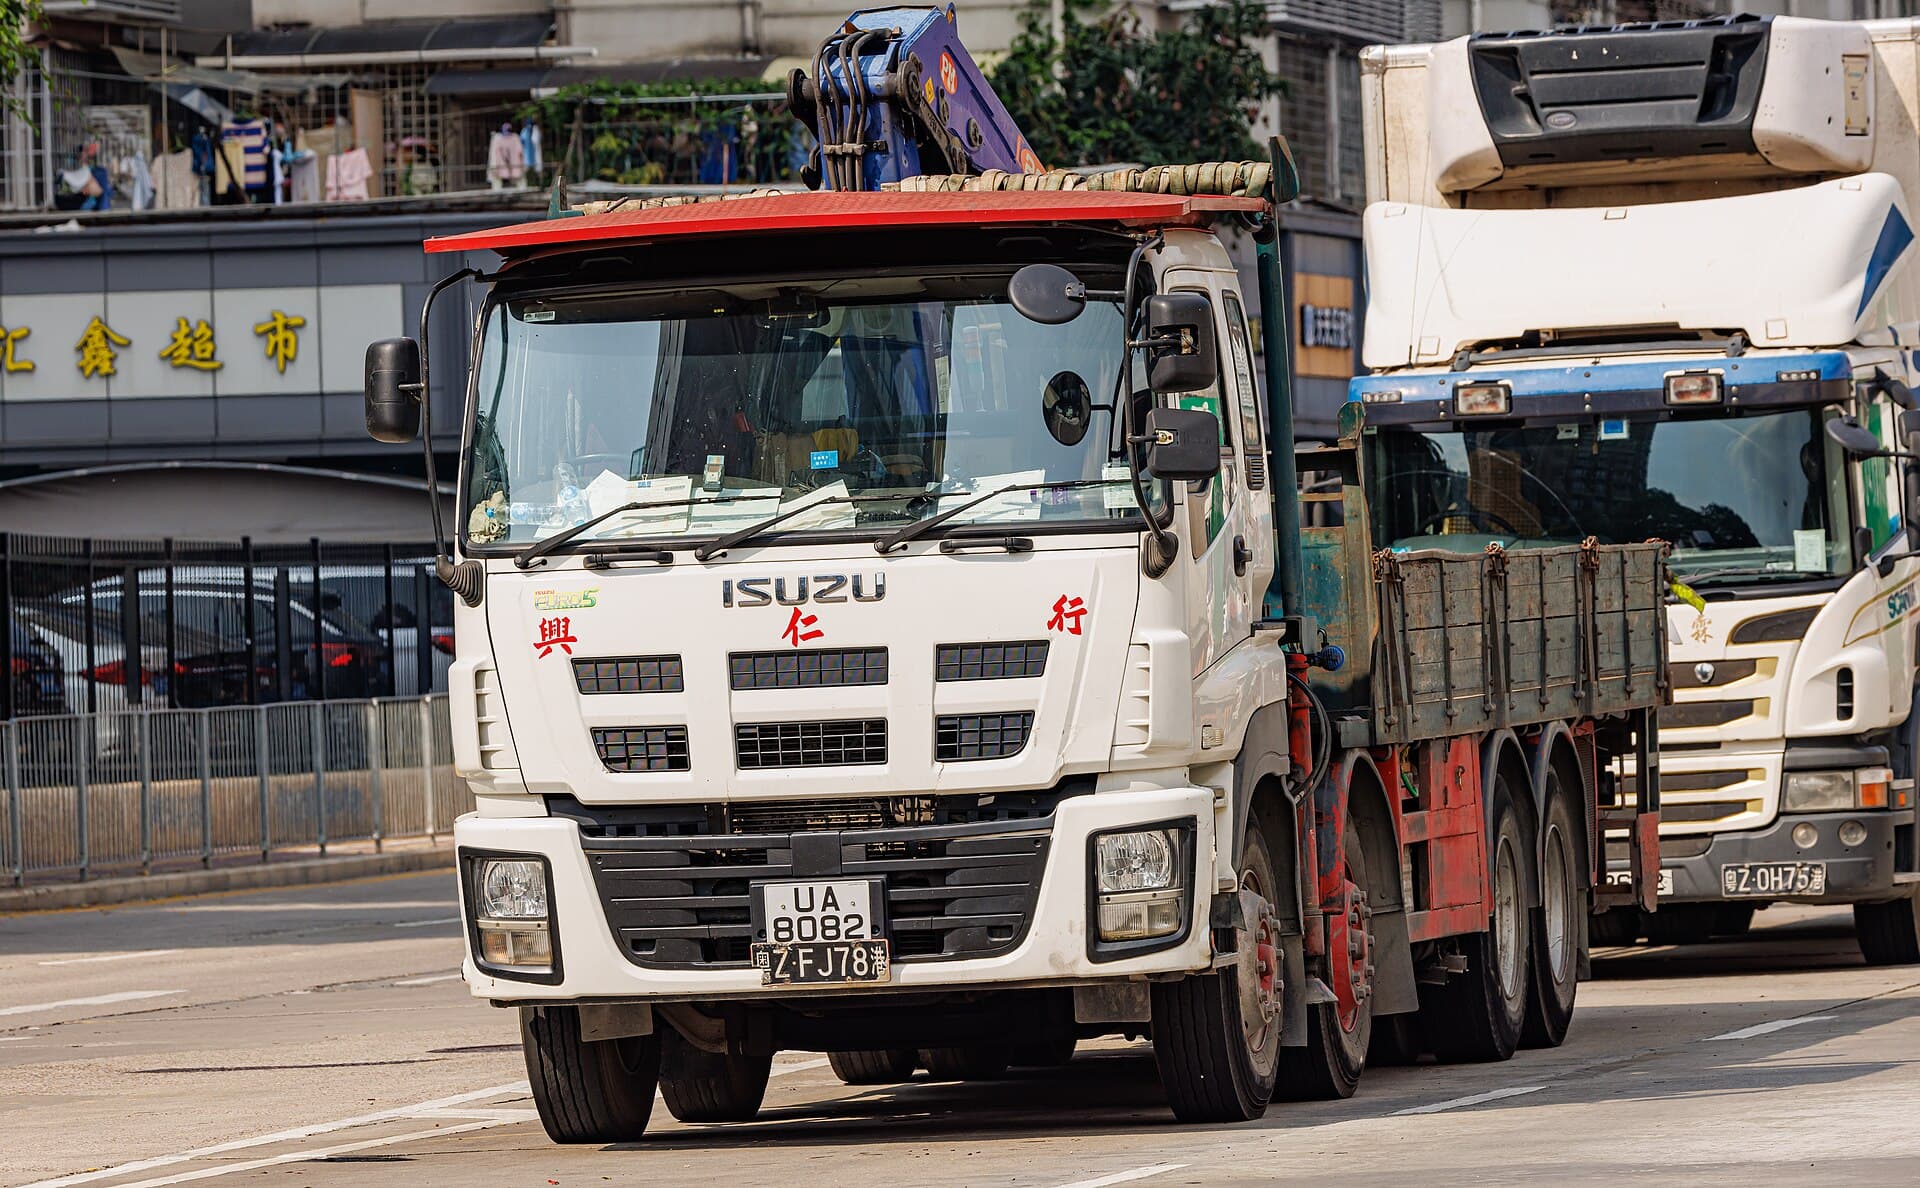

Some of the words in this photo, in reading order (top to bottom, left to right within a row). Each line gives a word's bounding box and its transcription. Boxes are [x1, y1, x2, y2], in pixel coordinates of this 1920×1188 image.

[0, 310, 306, 379] 汇鑫超市
[722, 572, 887, 608] ISUZU
[794, 886, 840, 912] UA
[773, 914, 864, 942] 8082
